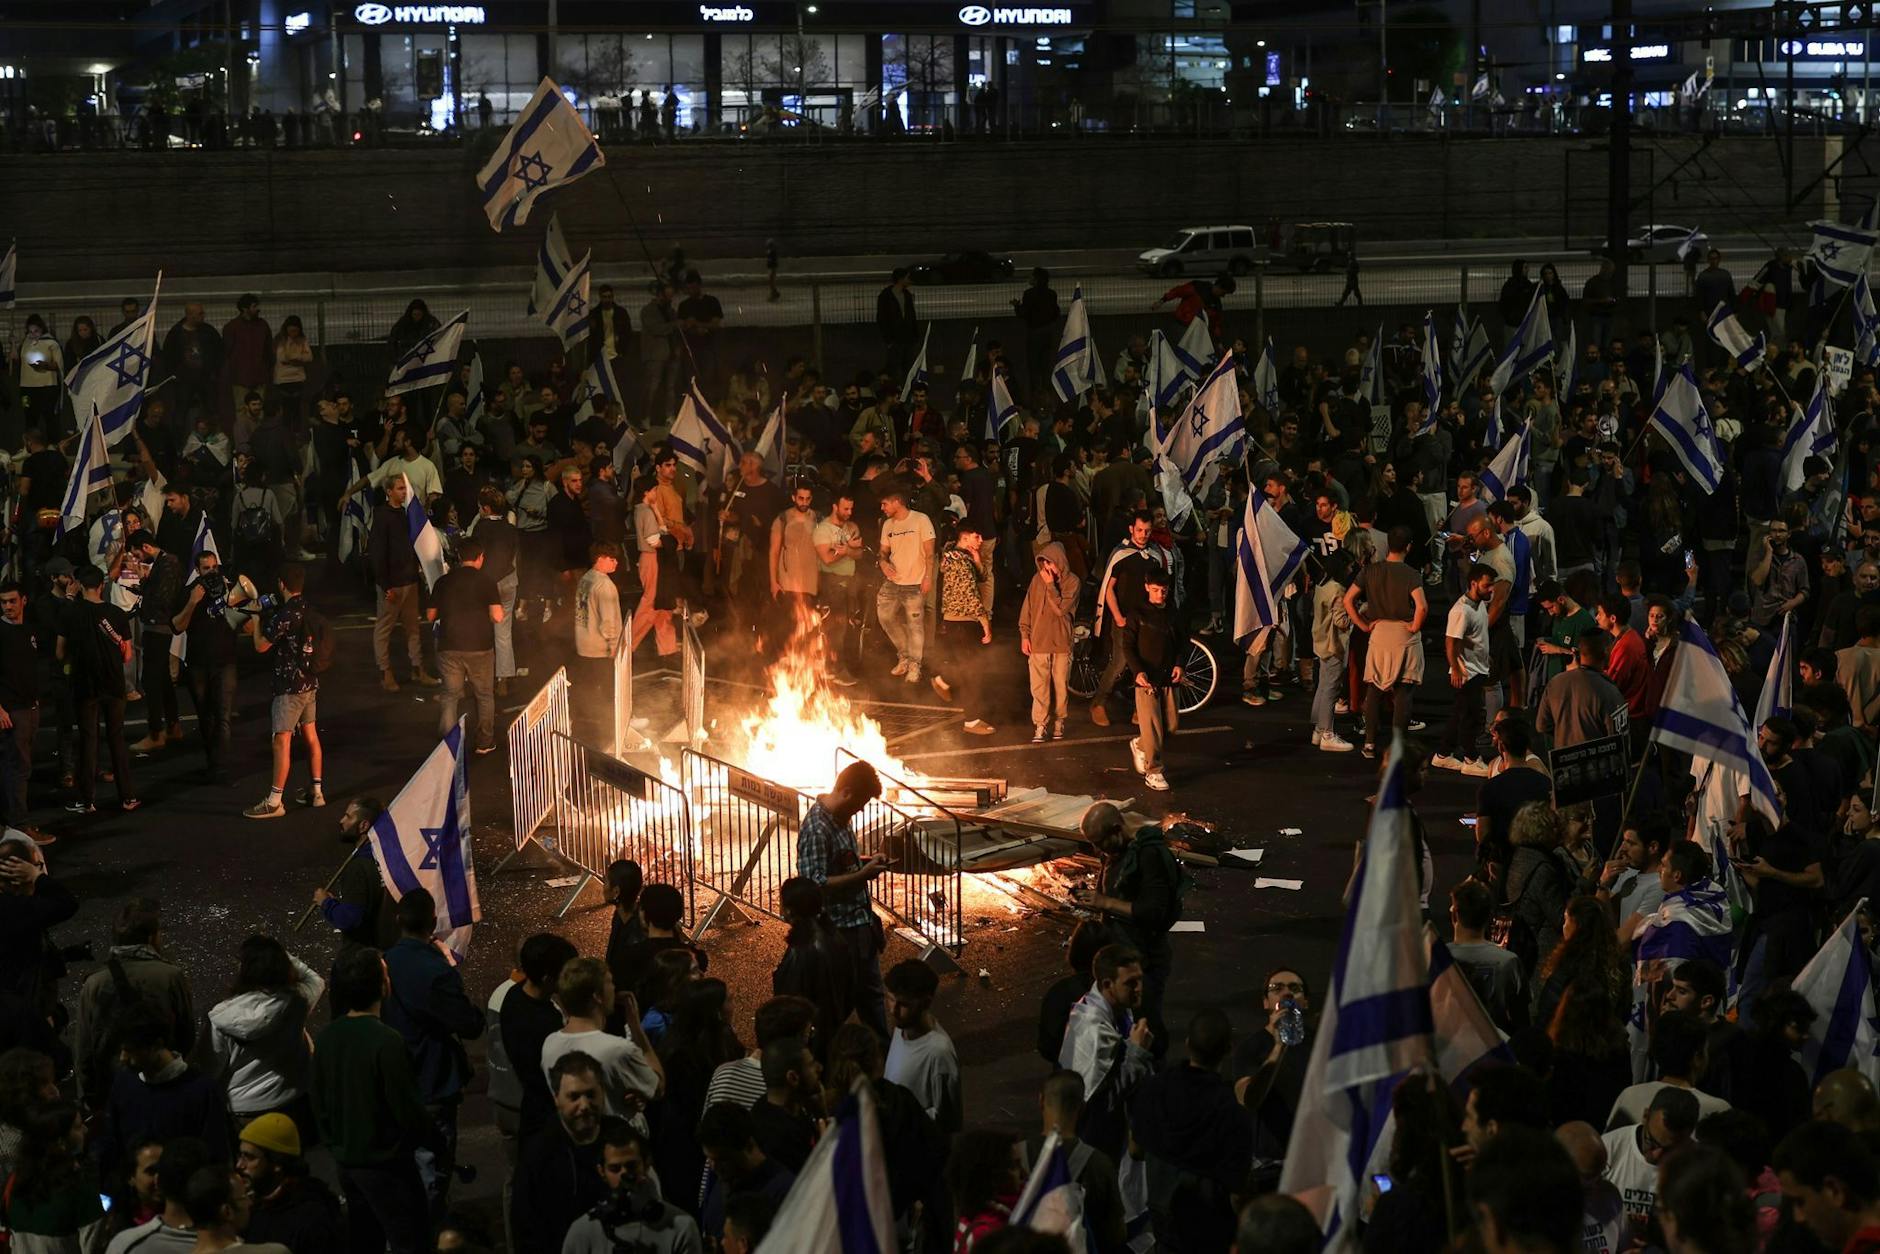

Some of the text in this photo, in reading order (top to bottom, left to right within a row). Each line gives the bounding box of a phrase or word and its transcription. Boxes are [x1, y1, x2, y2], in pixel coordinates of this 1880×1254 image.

[394, 6, 485, 23] HYUNDAI
[993, 8, 1072, 24] HYUNDAI
[1807, 42, 1864, 56] SUBARU
